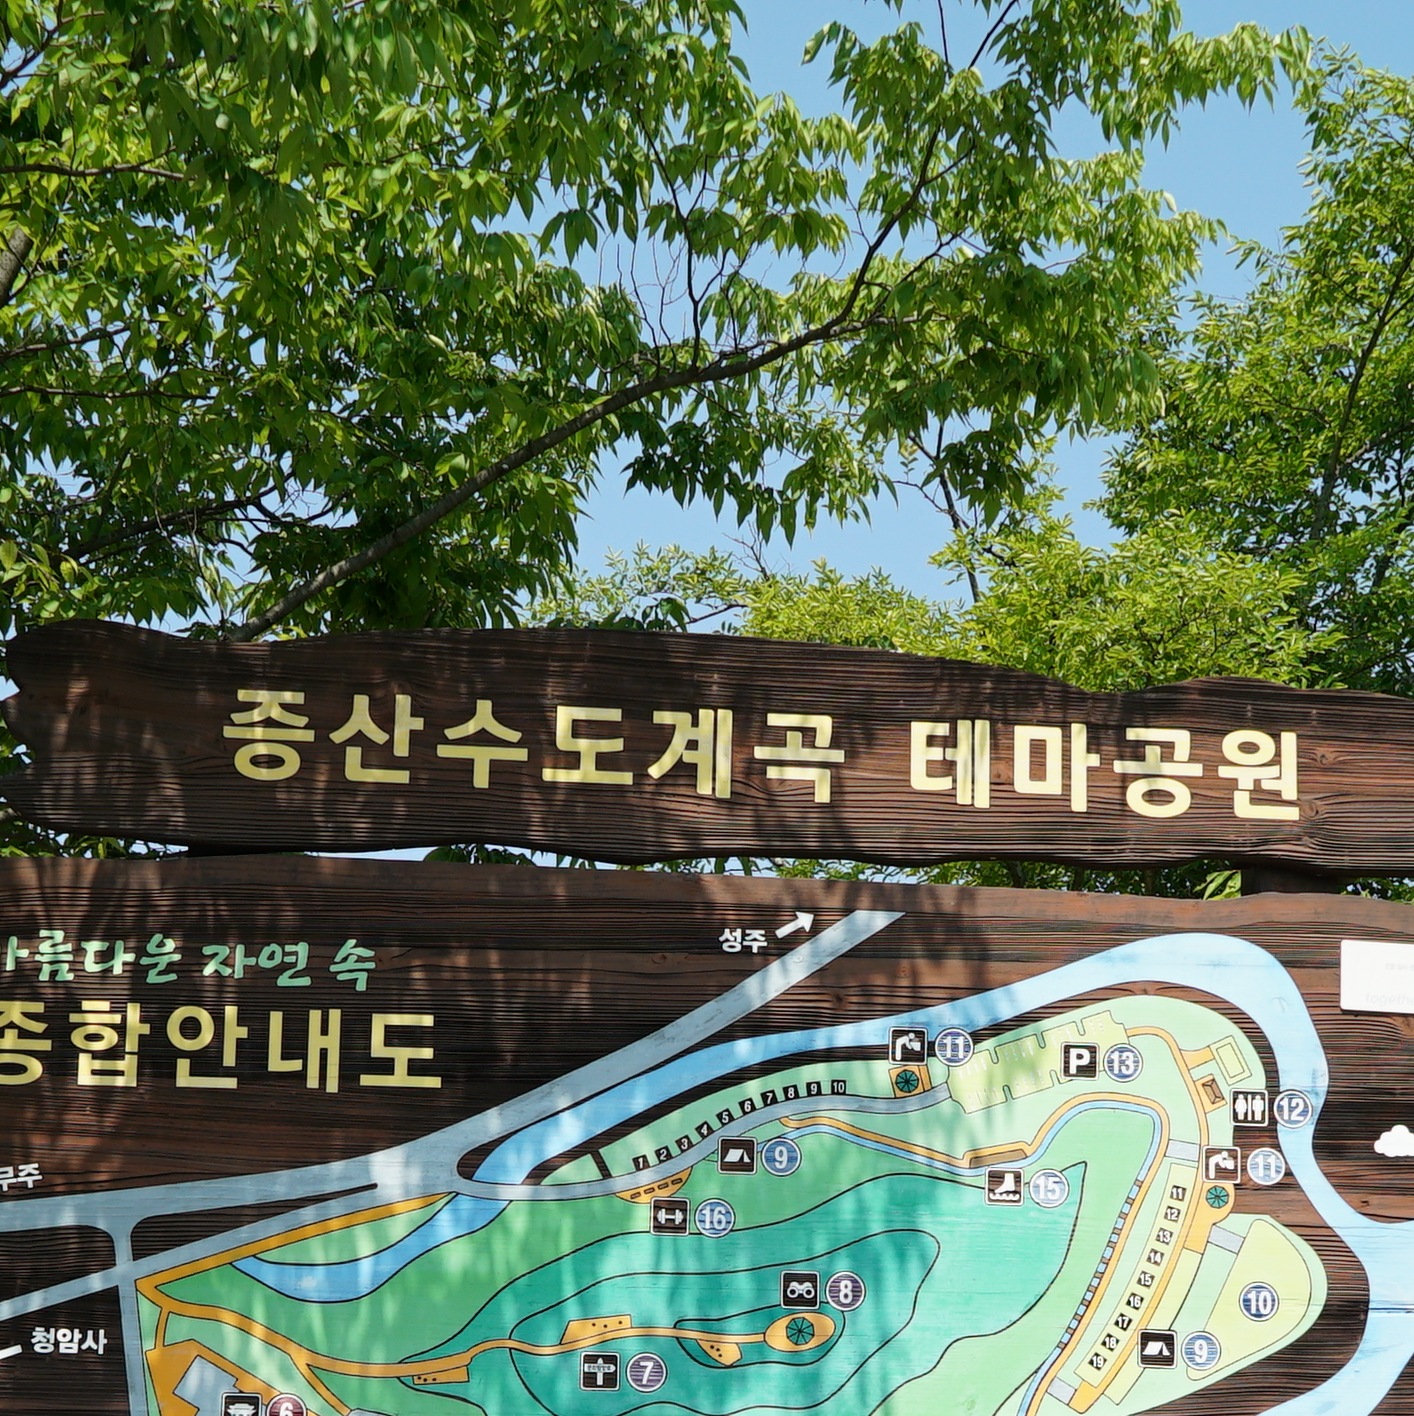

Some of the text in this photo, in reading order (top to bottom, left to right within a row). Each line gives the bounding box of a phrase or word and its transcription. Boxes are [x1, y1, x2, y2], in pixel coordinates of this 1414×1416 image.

[222, 689, 1300, 820] 증산수도계곡 테마공원
[719, 929, 768, 952] 성주
[202, 940, 312, 986] 자연
[329, 939, 376, 990] 속
[944, 1037, 964, 1059] 11
[1112, 1051, 1134, 1074] 13
[788, 1087, 794, 1098] 8
[811, 1084, 817, 1094] 9
[833, 1082, 844, 1093] 10
[766, 1093, 772, 1104] 7
[744, 1101, 751, 1112] 6
[1280, 1098, 1304, 1120] 12
[722, 1112, 728, 1123] 5
[701, 1124, 707, 1135] 4
[681, 1138, 688, 1150] 3
[660, 1149, 666, 1160] 2
[775, 1146, 788, 1169] 9
[638, 1158, 643, 1168] 1
[1257, 1155, 1277, 1177] 11
[1037, 1177, 1060, 1199] 15
[1172, 1188, 1183, 1199] 11
[703, 1207, 726, 1229] 16
[1166, 1209, 1178, 1220] 12
[1158, 1231, 1170, 1242] 13
[1149, 1252, 1161, 1263] 14
[1140, 1274, 1152, 1285] 15
[839, 1280, 852, 1303] 8
[1129, 1296, 1141, 1307] 16
[1247, 1291, 1271, 1314] 10
[1118, 1317, 1130, 1328] 17
[31, 1327, 107, 1355] 청암사
[1104, 1337, 1117, 1349] 18
[1195, 1340, 1207, 1363] 9
[1092, 1356, 1104, 1367] 19
[640, 1362, 653, 1384] 7
